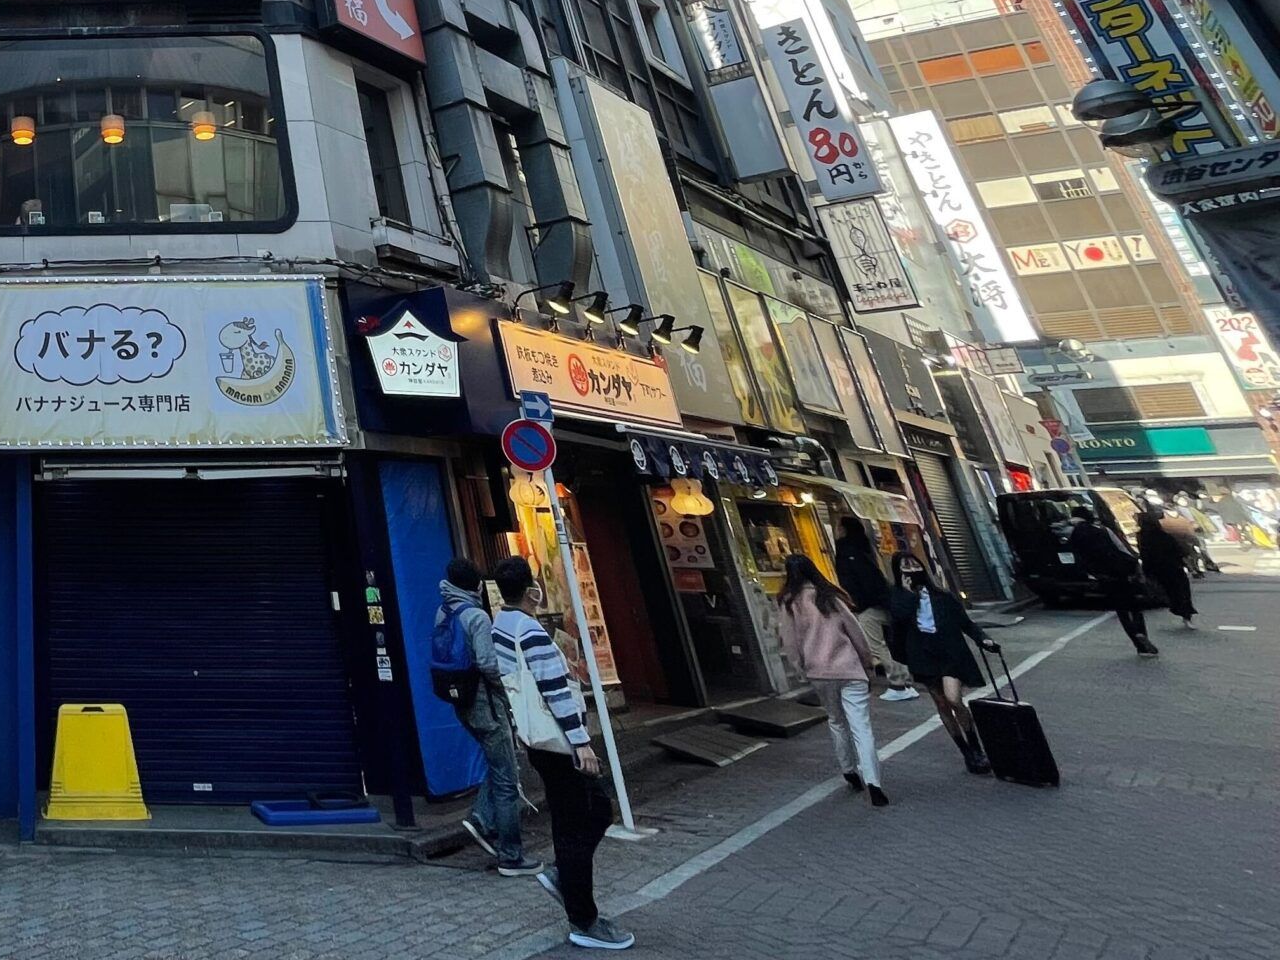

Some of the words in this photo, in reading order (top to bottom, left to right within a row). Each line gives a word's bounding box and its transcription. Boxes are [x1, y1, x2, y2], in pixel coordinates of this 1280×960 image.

[961, 251, 1009, 311] 大将
[37, 329, 163, 360] バナる?
[391, 346, 436, 357] 大衆スタンド
[225, 386, 263, 403] MAGARI
[275, 358, 293, 393] BANANA
[399, 361, 448, 377] カンダヤ
[588, 368, 632, 401] カンダヤ
[15, 395, 191, 413] バナナジュース専門店
[1077, 438, 1136, 449] RONTO
